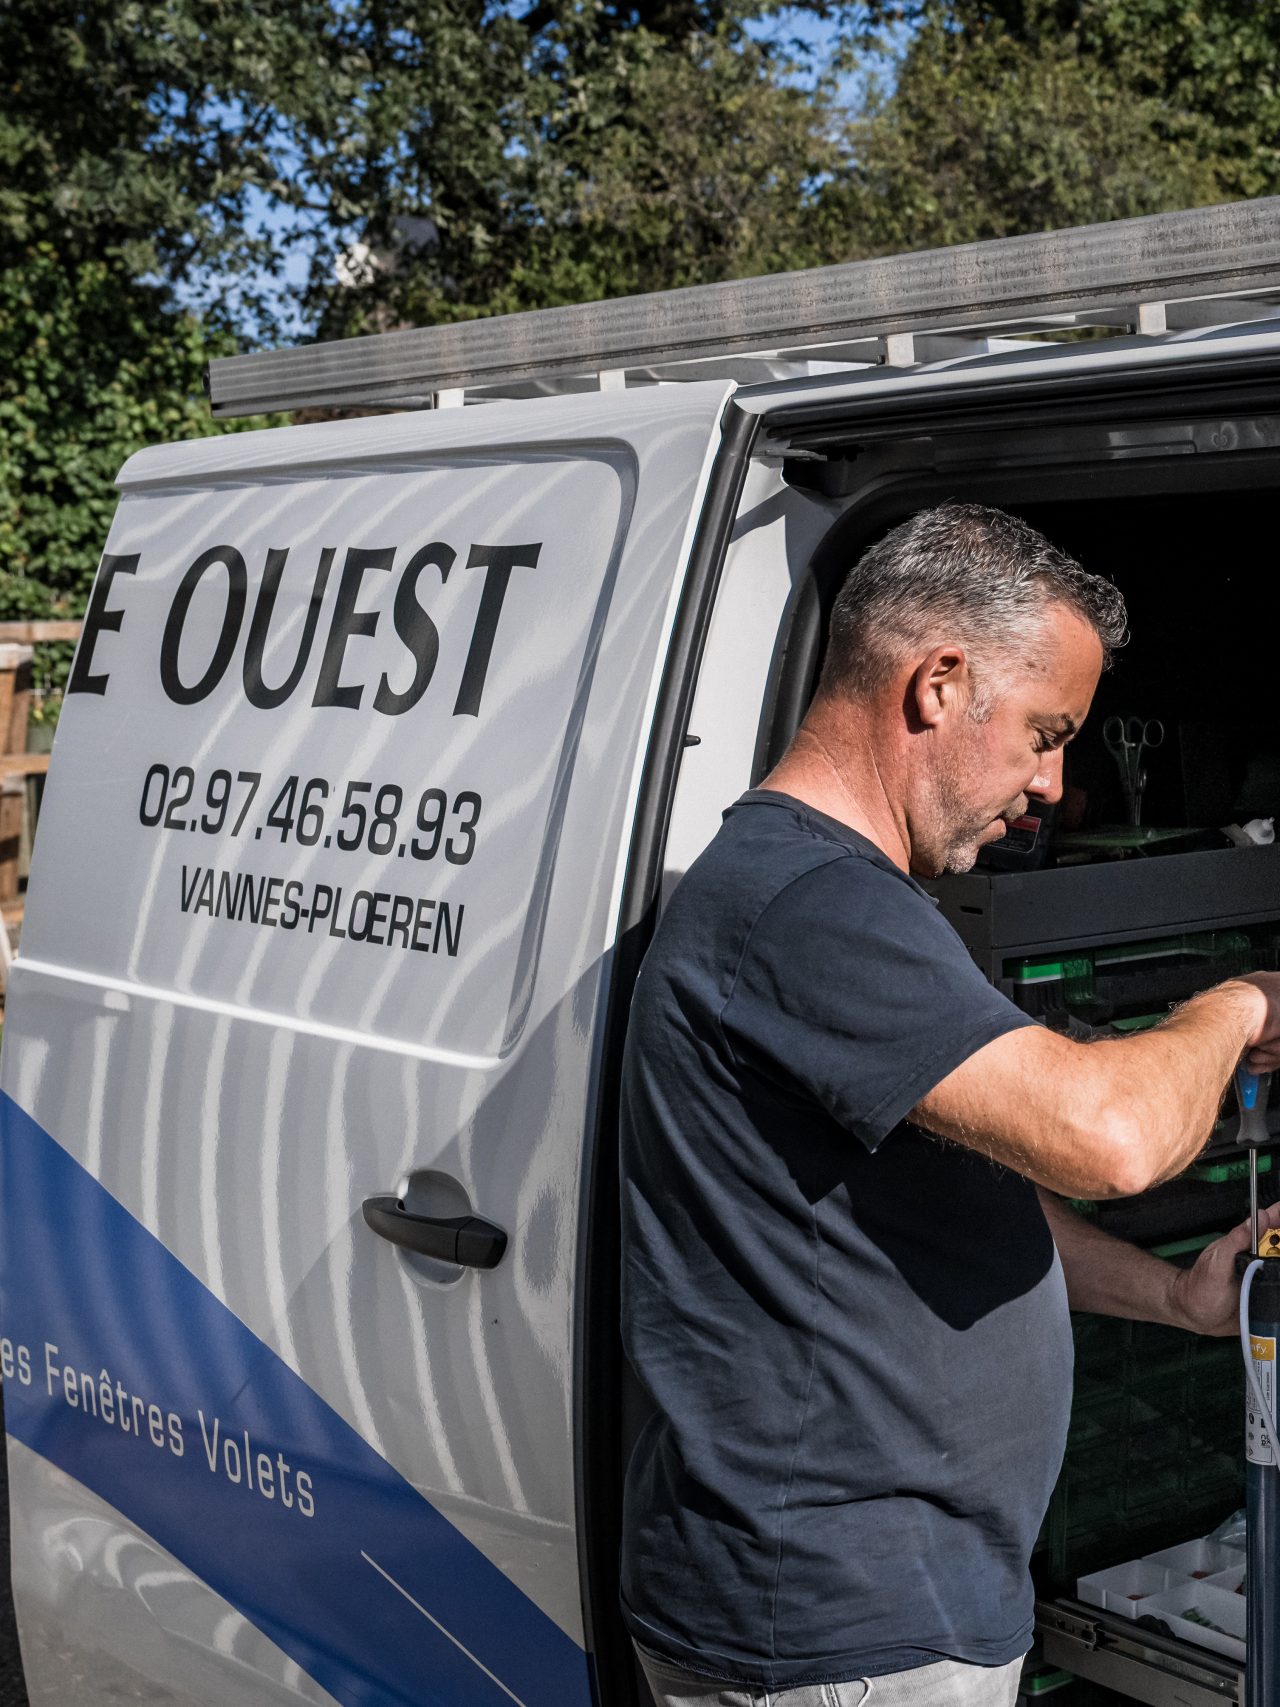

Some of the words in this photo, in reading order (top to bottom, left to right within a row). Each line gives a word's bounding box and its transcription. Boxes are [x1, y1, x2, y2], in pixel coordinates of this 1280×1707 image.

[67, 552, 142, 696] E
[159, 541, 543, 718] OUEST
[139, 762, 482, 866] 02.97.46.58.93
[180, 864, 465, 957] VANNES-PLŒREN
[45, 1342, 184, 1457] Fenêtres
[197, 1409, 316, 1518] Volets
